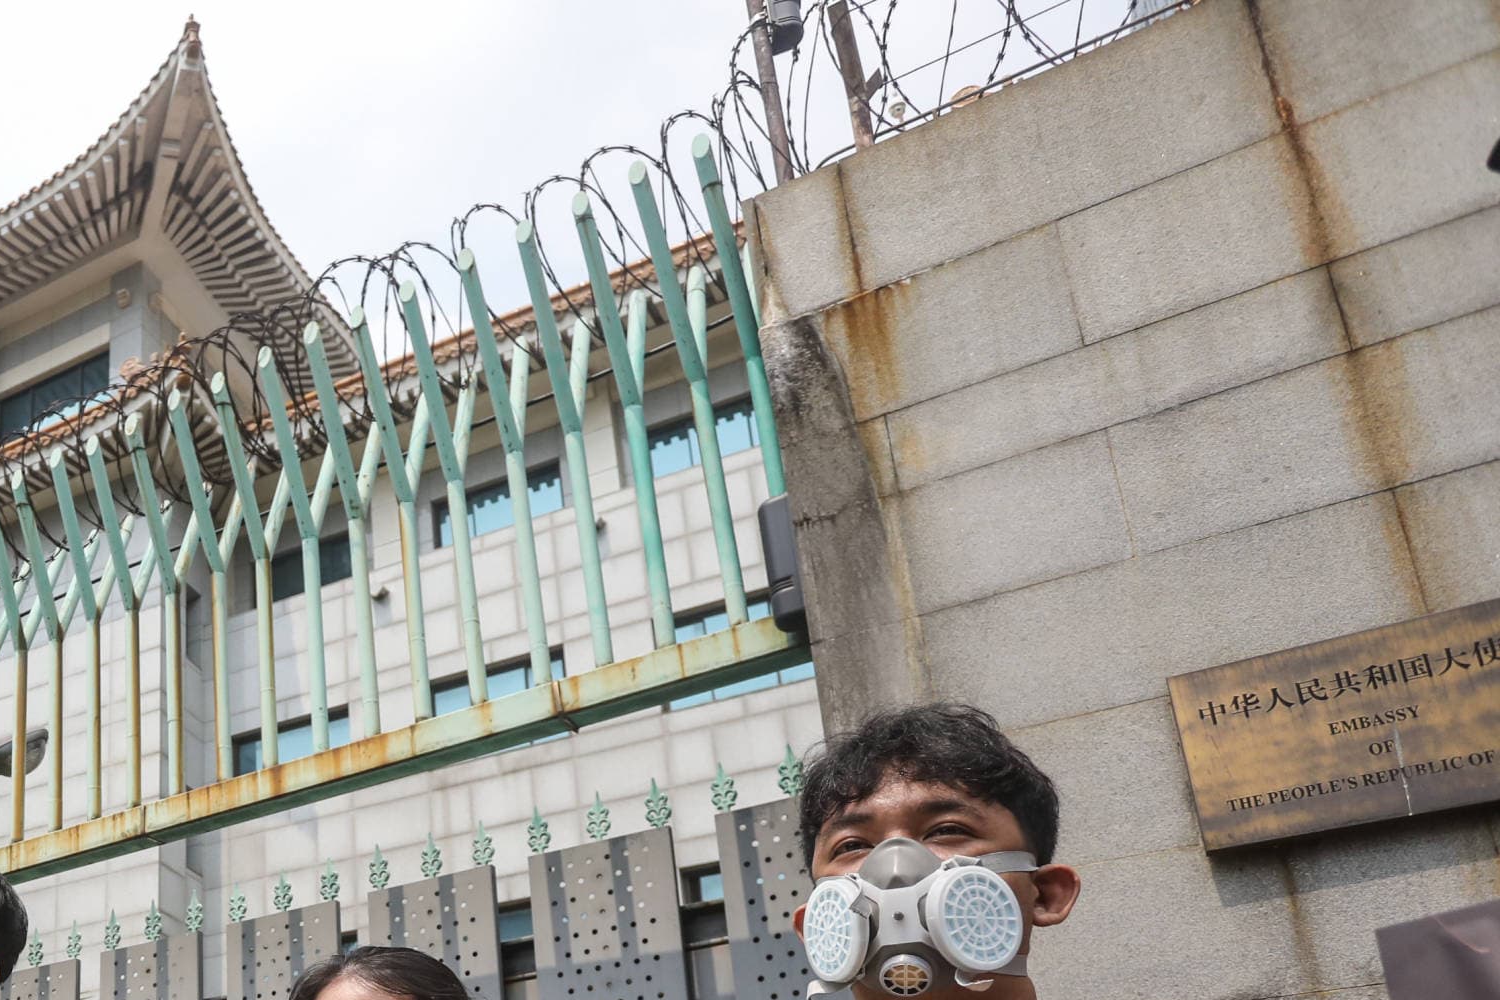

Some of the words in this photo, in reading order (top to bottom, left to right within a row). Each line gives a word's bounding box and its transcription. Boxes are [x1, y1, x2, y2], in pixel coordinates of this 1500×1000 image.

[1328, 705, 1420, 735] EMBASSY
[1368, 739, 1396, 756] OF
[1227, 794, 1265, 812] THE
[1268, 775, 1359, 806] PEOPLE'S
[1362, 756, 1463, 787] REPUBLIC
[1468, 749, 1496, 768] OF
